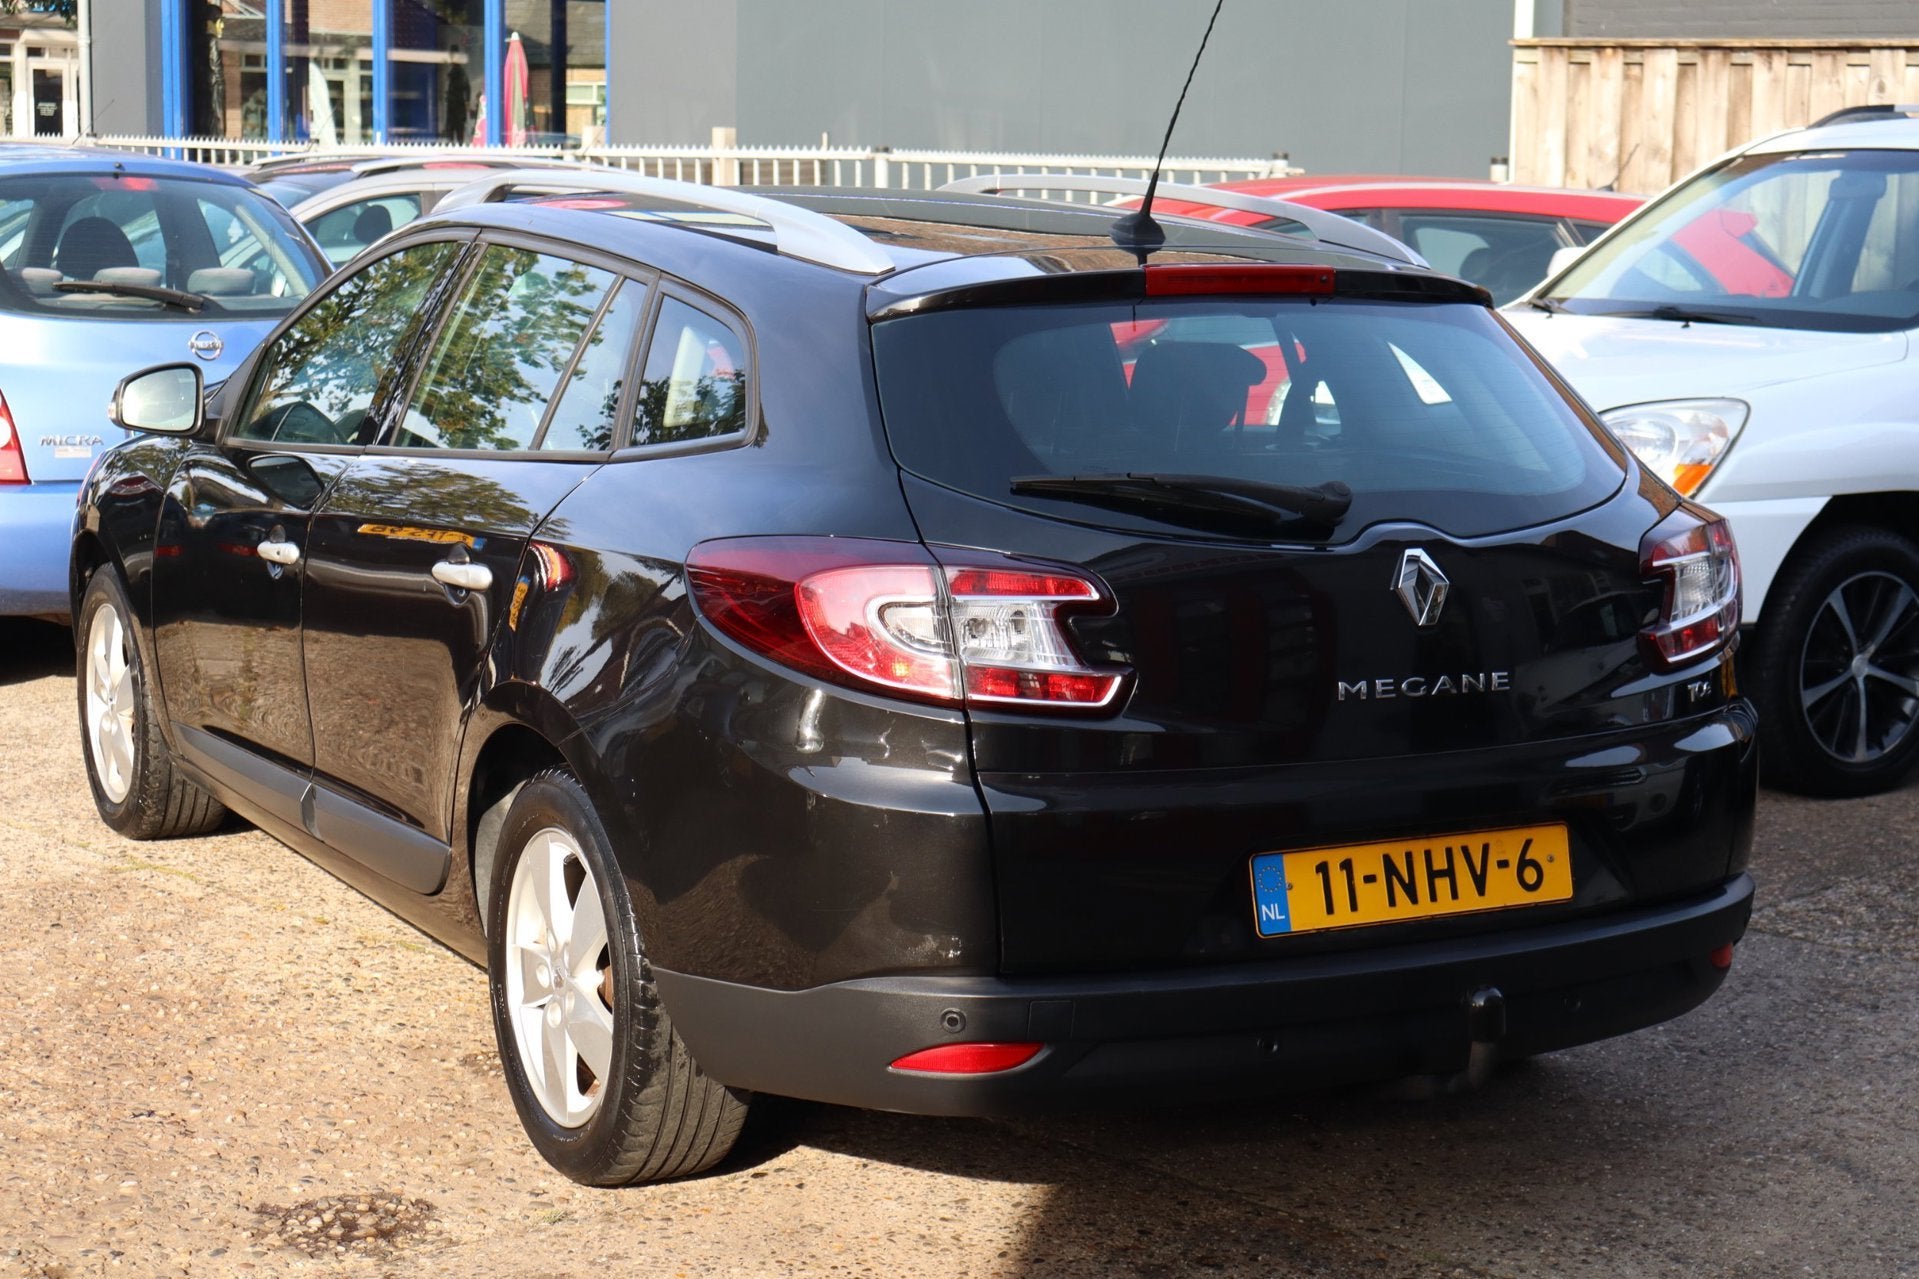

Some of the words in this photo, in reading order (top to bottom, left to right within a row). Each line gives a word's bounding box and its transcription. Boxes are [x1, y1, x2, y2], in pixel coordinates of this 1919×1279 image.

[41, 434, 104, 446] MICRA
[1338, 671, 1511, 701] MEGANE
[1315, 838, 1544, 915] 11-NHV-6
[1261, 903, 1285, 921] NL
